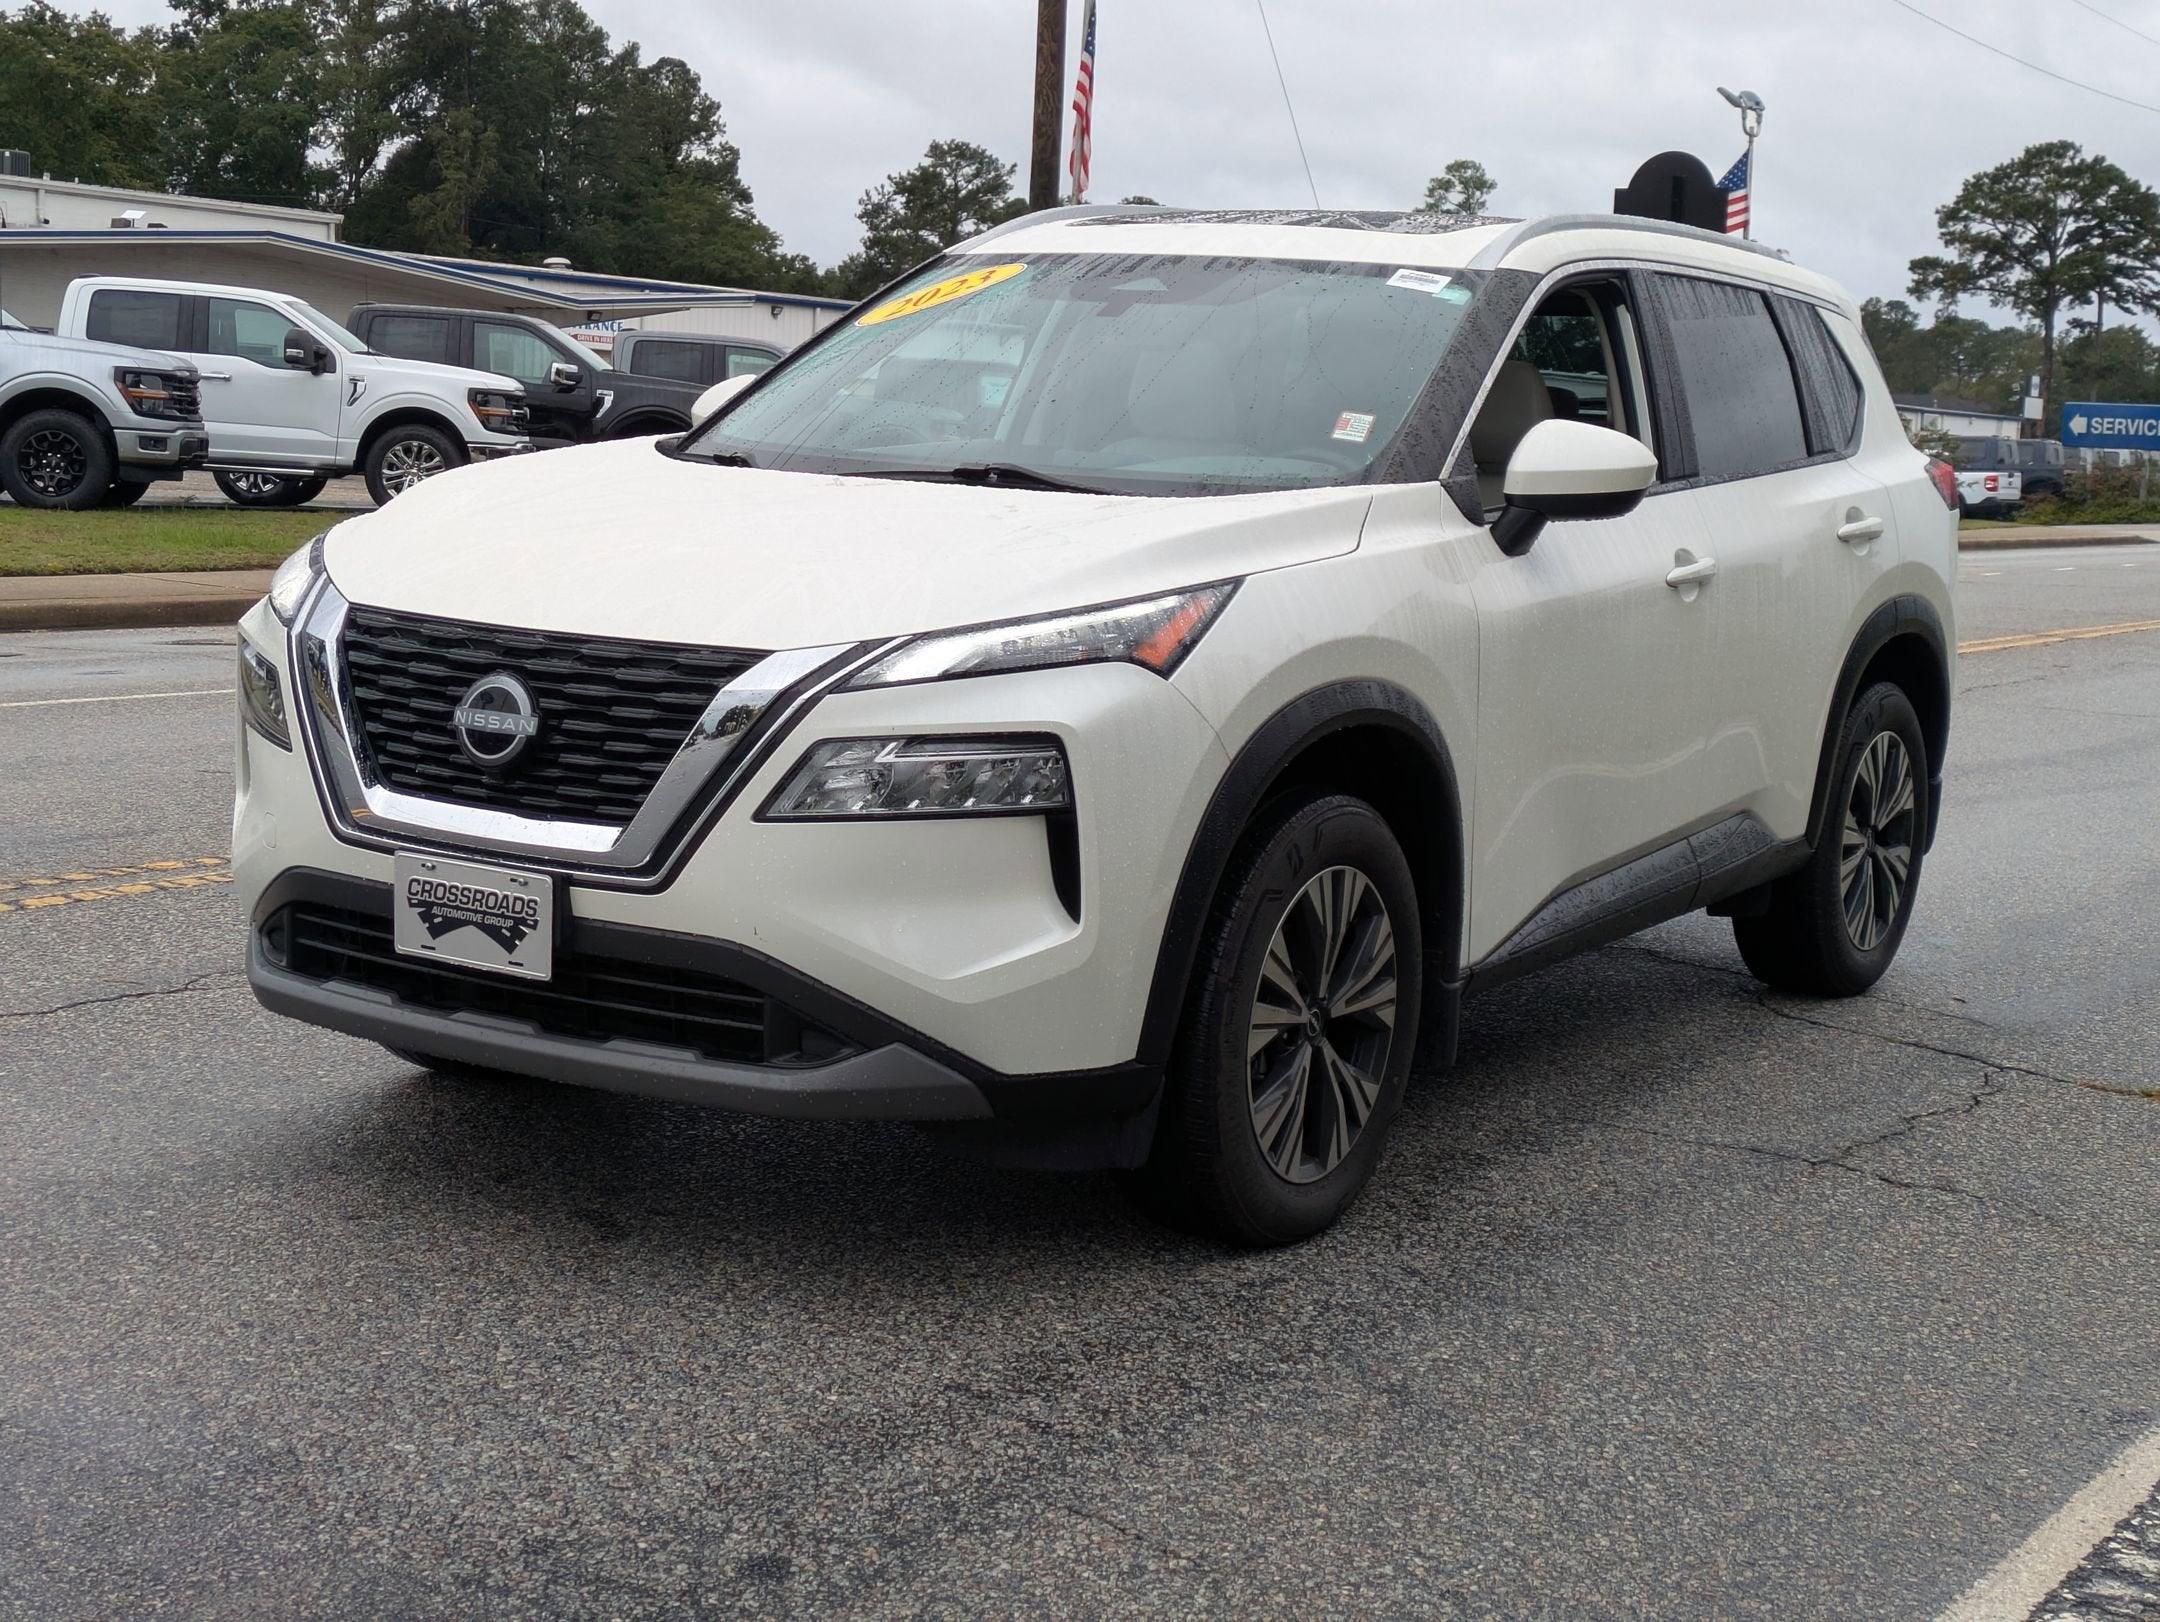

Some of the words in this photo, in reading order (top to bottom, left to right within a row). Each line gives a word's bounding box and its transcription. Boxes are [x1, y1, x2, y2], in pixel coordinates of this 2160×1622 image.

[881, 269, 997, 320] 2023
[2090, 417, 2160, 436] SERVIC
[455, 710, 534, 733] NISSAN
[407, 877, 540, 919] CROSSROADS
[431, 905, 484, 923] AUTOMOTIVE
[484, 915, 514, 928] GROUP
